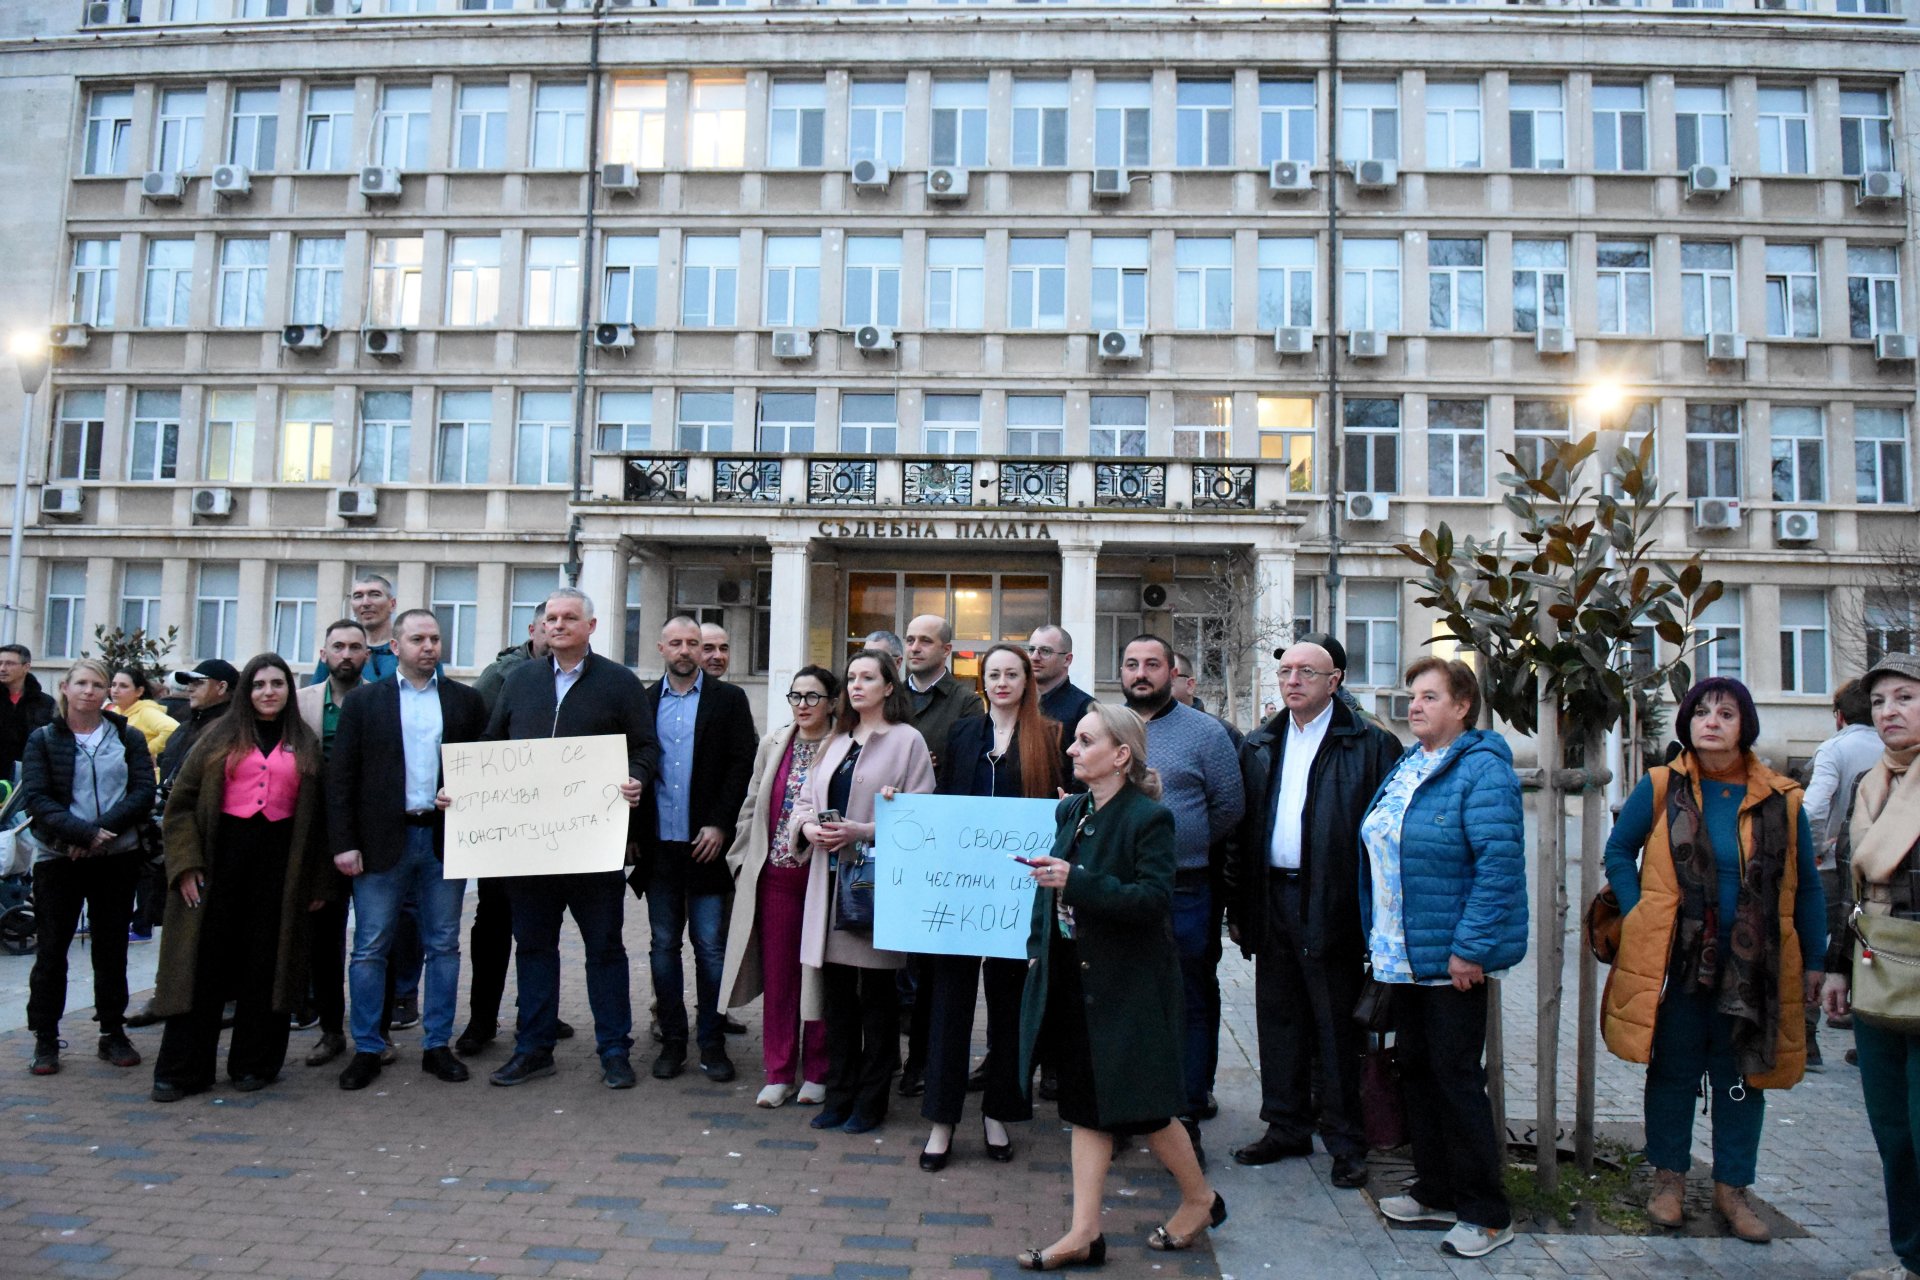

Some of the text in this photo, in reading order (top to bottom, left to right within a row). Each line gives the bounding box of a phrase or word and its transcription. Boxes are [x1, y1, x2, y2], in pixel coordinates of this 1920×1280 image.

[818, 520, 1051, 539] СЪДЕБНА ПАЛАТА
[450, 742, 535, 777] #КОЙ
[455, 780, 586, 812] СТРАХУВА ОТ
[892, 866, 903, 886] И
[925, 871, 995, 890] ЧЕСТНИ
[921, 899, 1020, 933] #КОЙ
